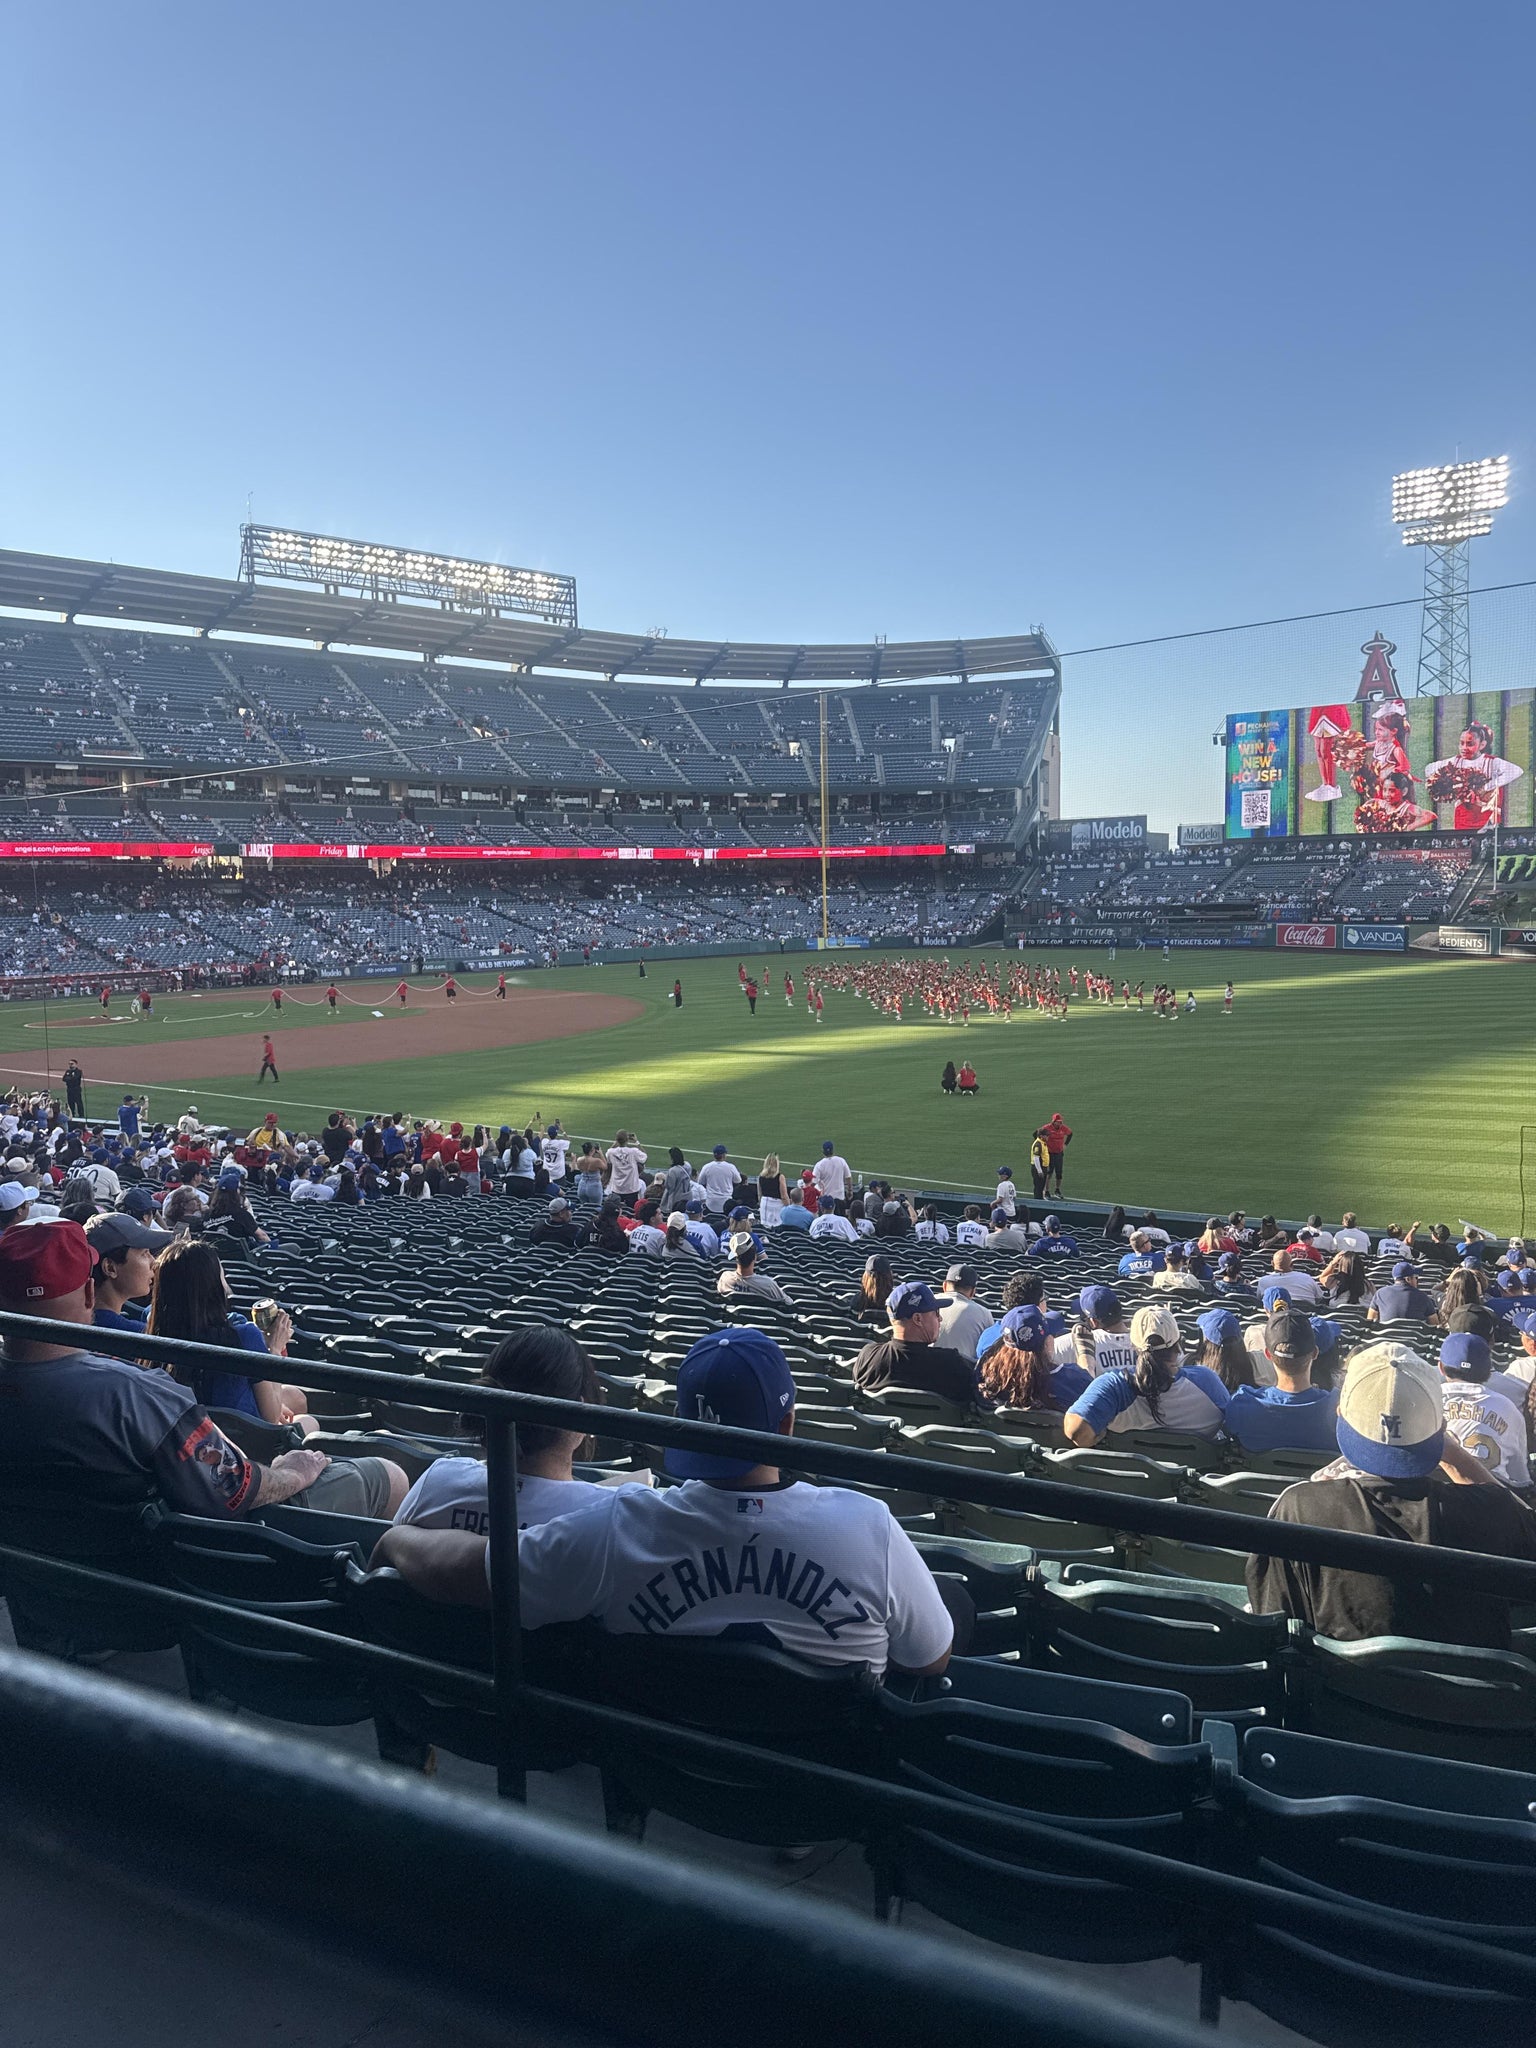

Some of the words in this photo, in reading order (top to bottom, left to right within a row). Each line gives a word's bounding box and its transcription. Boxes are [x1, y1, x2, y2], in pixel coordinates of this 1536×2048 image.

[1352, 630, 1405, 702] A
[1238, 743, 1264, 755] WIN
[1267, 740, 1277, 753] A
[1242, 756, 1273, 768] NEW
[1232, 769, 1282, 783] HOUSE!
[1092, 821, 1142, 839] Modelo
[1185, 827, 1218, 840] Modelo
[249, 844, 274, 857] JACKET
[319, 846, 344, 856] Friday
[685, 848, 703, 858] Friday
[1097, 908, 1153, 920] NITTOTIRE.CO
[923, 937, 947, 945] Modelo
[1360, 931, 1404, 942] VANDA
[1523, 932, 1536, 942] YO
[478, 961, 493, 969] MLB
[494, 959, 526, 968] NETWORK
[321, 969, 341, 977] Modelo
[544, 1152, 557, 1163] 37
[958, 1225, 982, 1235] FREEMAN
[631, 1231, 649, 1242] BETTS
[964, 1235, 973, 1245] 5
[1048, 1245, 1072, 1254] FREEMAN
[1128, 1260, 1153, 1271] TUCKER
[696, 1393, 720, 1424] LA
[628, 1533, 870, 1640] HERNÁNDEZ
